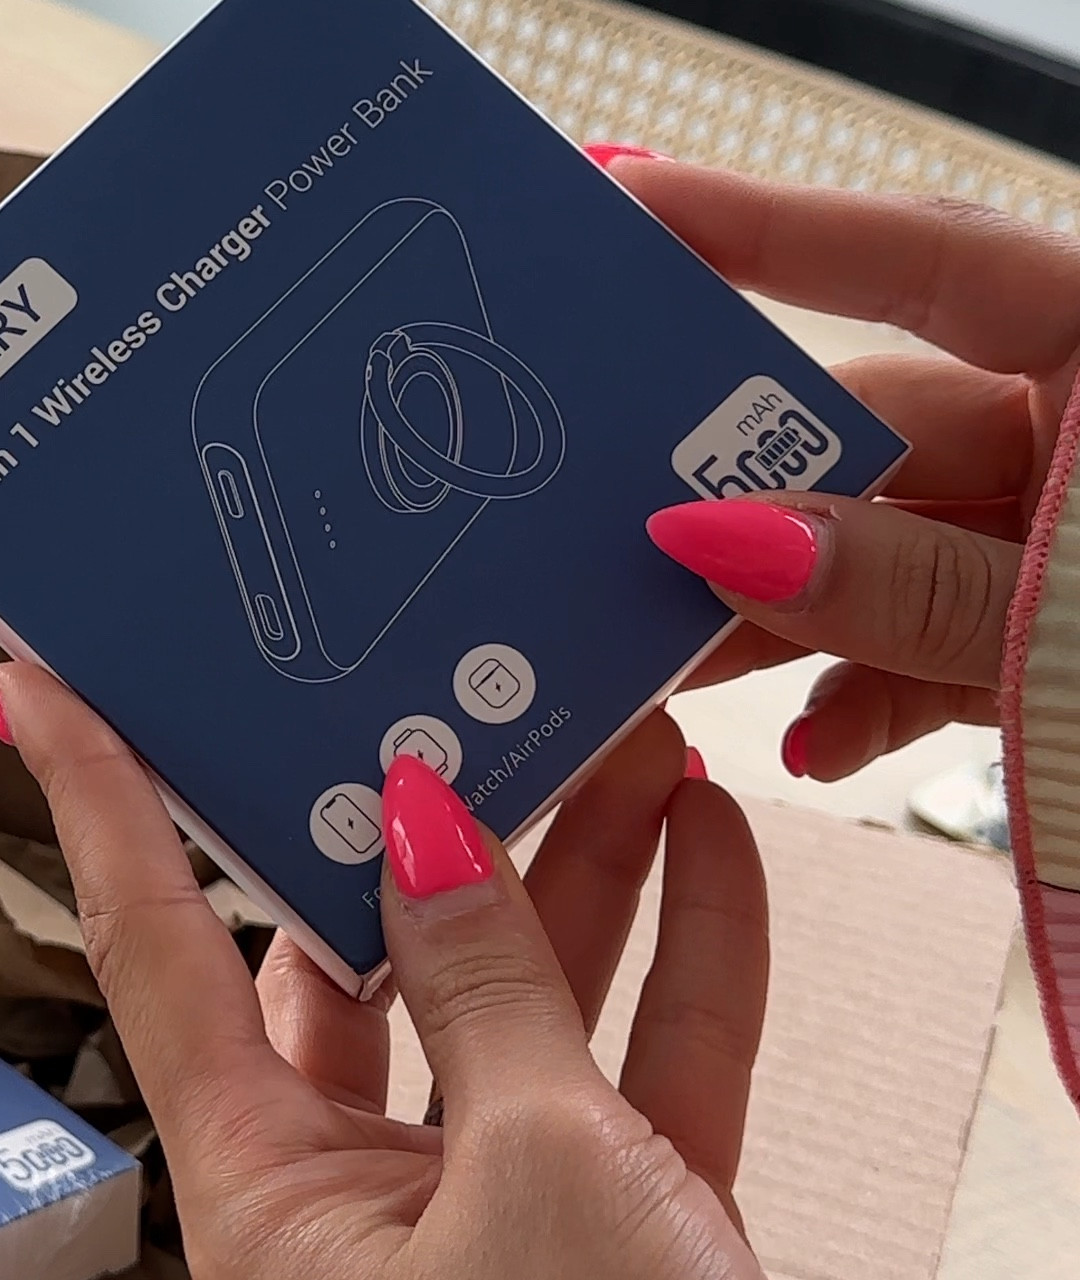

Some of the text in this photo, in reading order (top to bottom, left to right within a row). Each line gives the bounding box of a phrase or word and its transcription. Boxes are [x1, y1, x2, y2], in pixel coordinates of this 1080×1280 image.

[9, 422, 39, 448] 1
[31, 310, 162, 427] Wireless
[155, 204, 271, 312] Charger
[264, 122, 358, 210] Power
[352, 58, 433, 129] Bank
[736, 391, 784, 437] mAh
[361, 886, 381, 909] Fo
